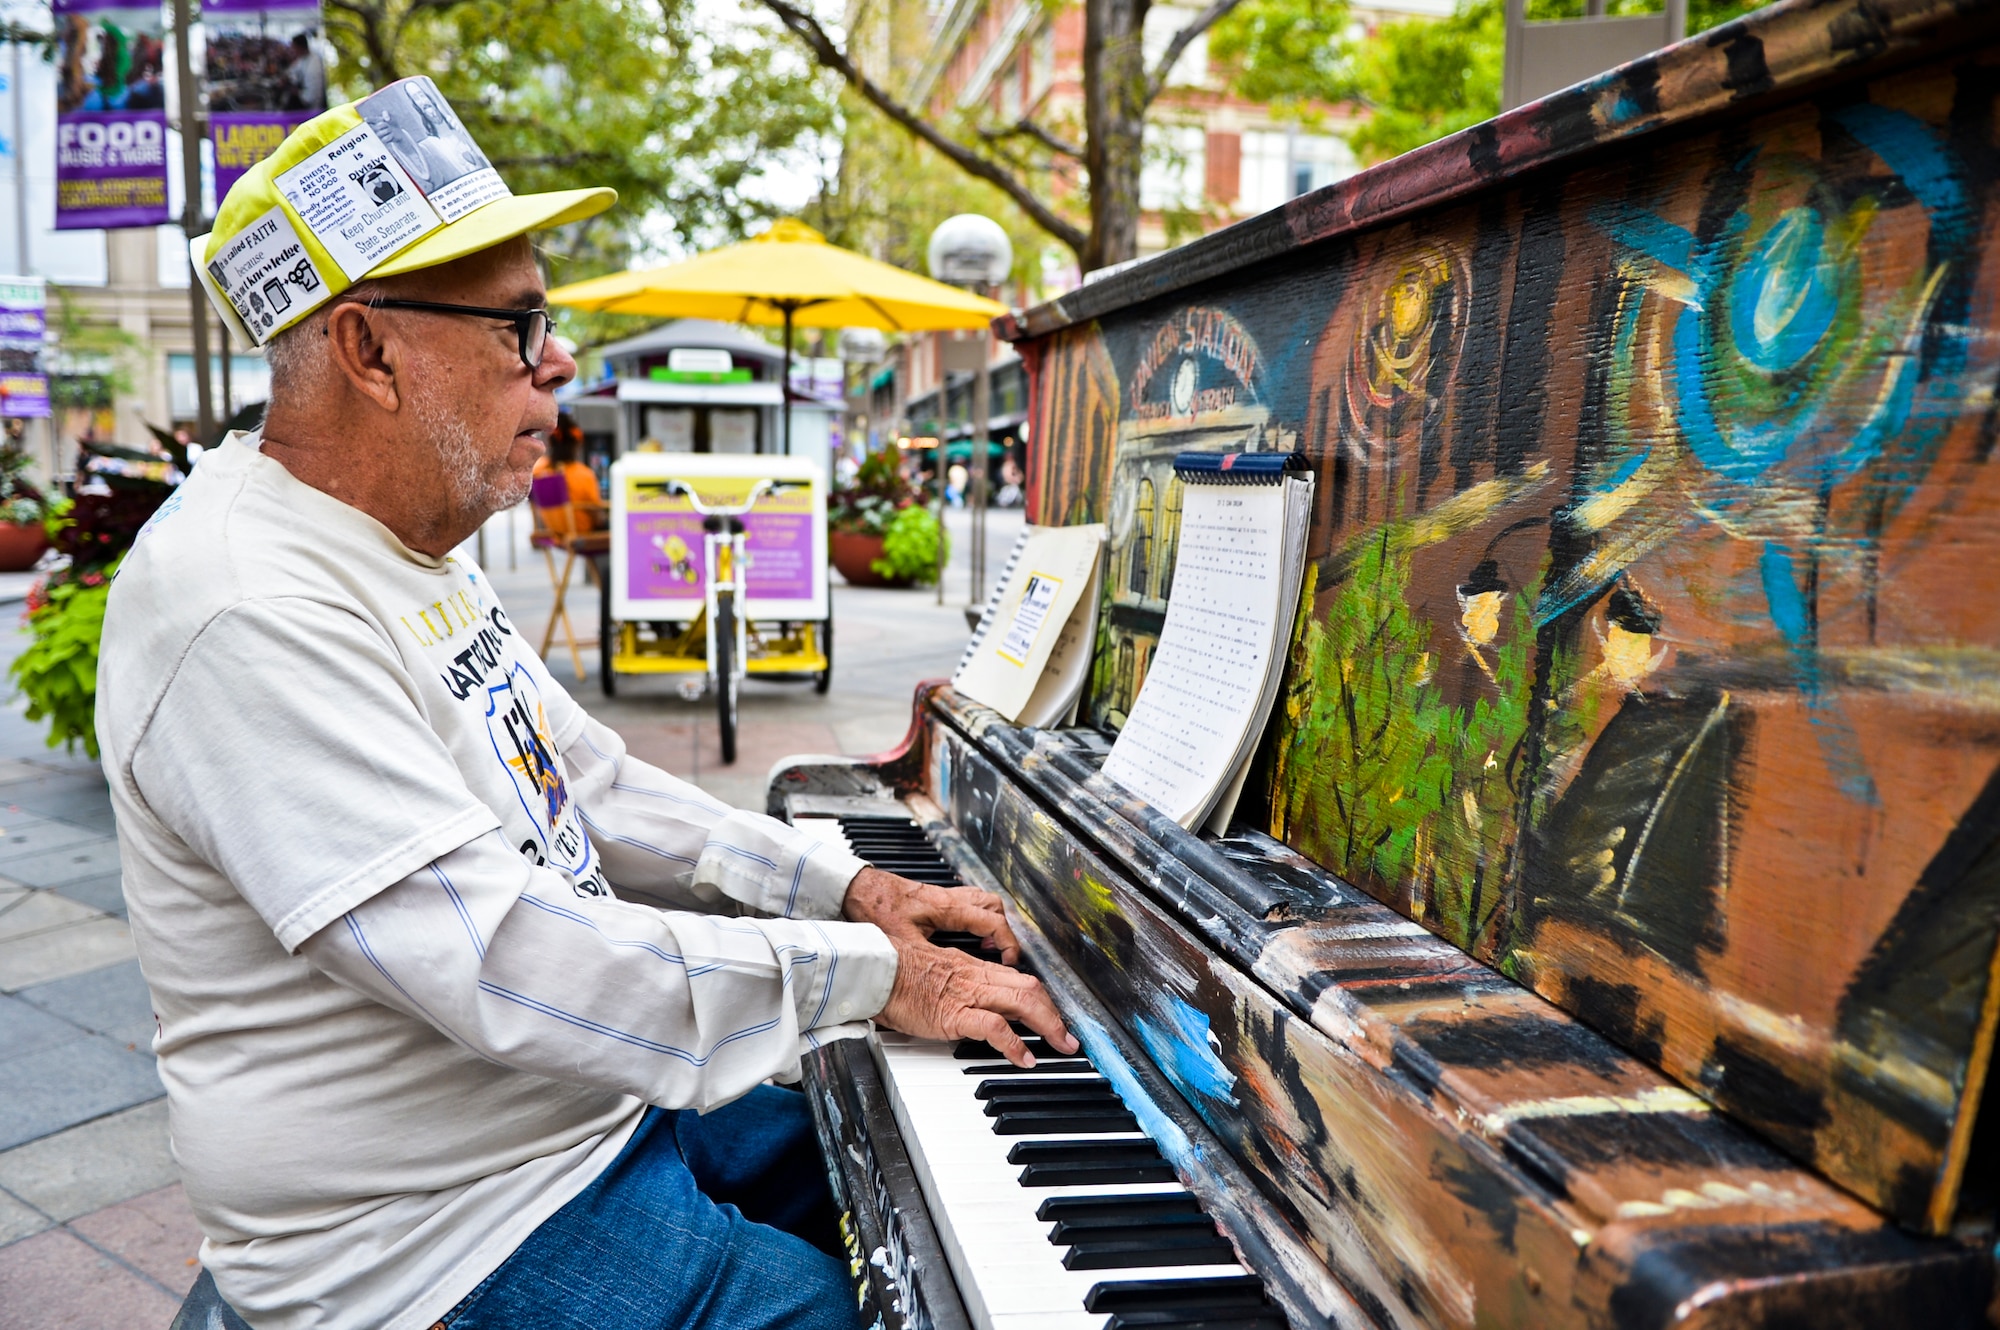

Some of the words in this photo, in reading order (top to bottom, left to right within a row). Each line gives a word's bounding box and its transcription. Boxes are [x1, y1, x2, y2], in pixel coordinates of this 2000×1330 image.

[58, 119, 163, 149] FOOD
[214, 124, 286, 151] LABOR
[328, 132, 368, 161] Religion
[60, 147, 104, 168] MUSIC
[122, 146, 164, 166] MORE
[348, 154, 387, 181] Divisive
[299, 163, 330, 186] ATHEISTS
[302, 181, 317, 193] ARE
[317, 174, 326, 184] UP
[325, 168, 337, 179] TO
[299, 202, 321, 217] Godly
[321, 185, 345, 203] dogma
[308, 187, 321, 198] NO
[308, 203, 335, 223] pollutes
[335, 194, 347, 205] the
[311, 211, 336, 229] human
[340, 222, 365, 241] Keep
[361, 201, 396, 226] Church
[395, 191, 411, 206] and
[227, 240, 246, 260] called
[245, 219, 278, 249] FAITH
[355, 234, 380, 255] State
[377, 211, 420, 239] Separate.
[367, 223, 422, 261] liarsforjesus.com
[234, 251, 265, 277] because
[246, 243, 301, 286] knowledge
[1184, 306, 1257, 390] STATION
